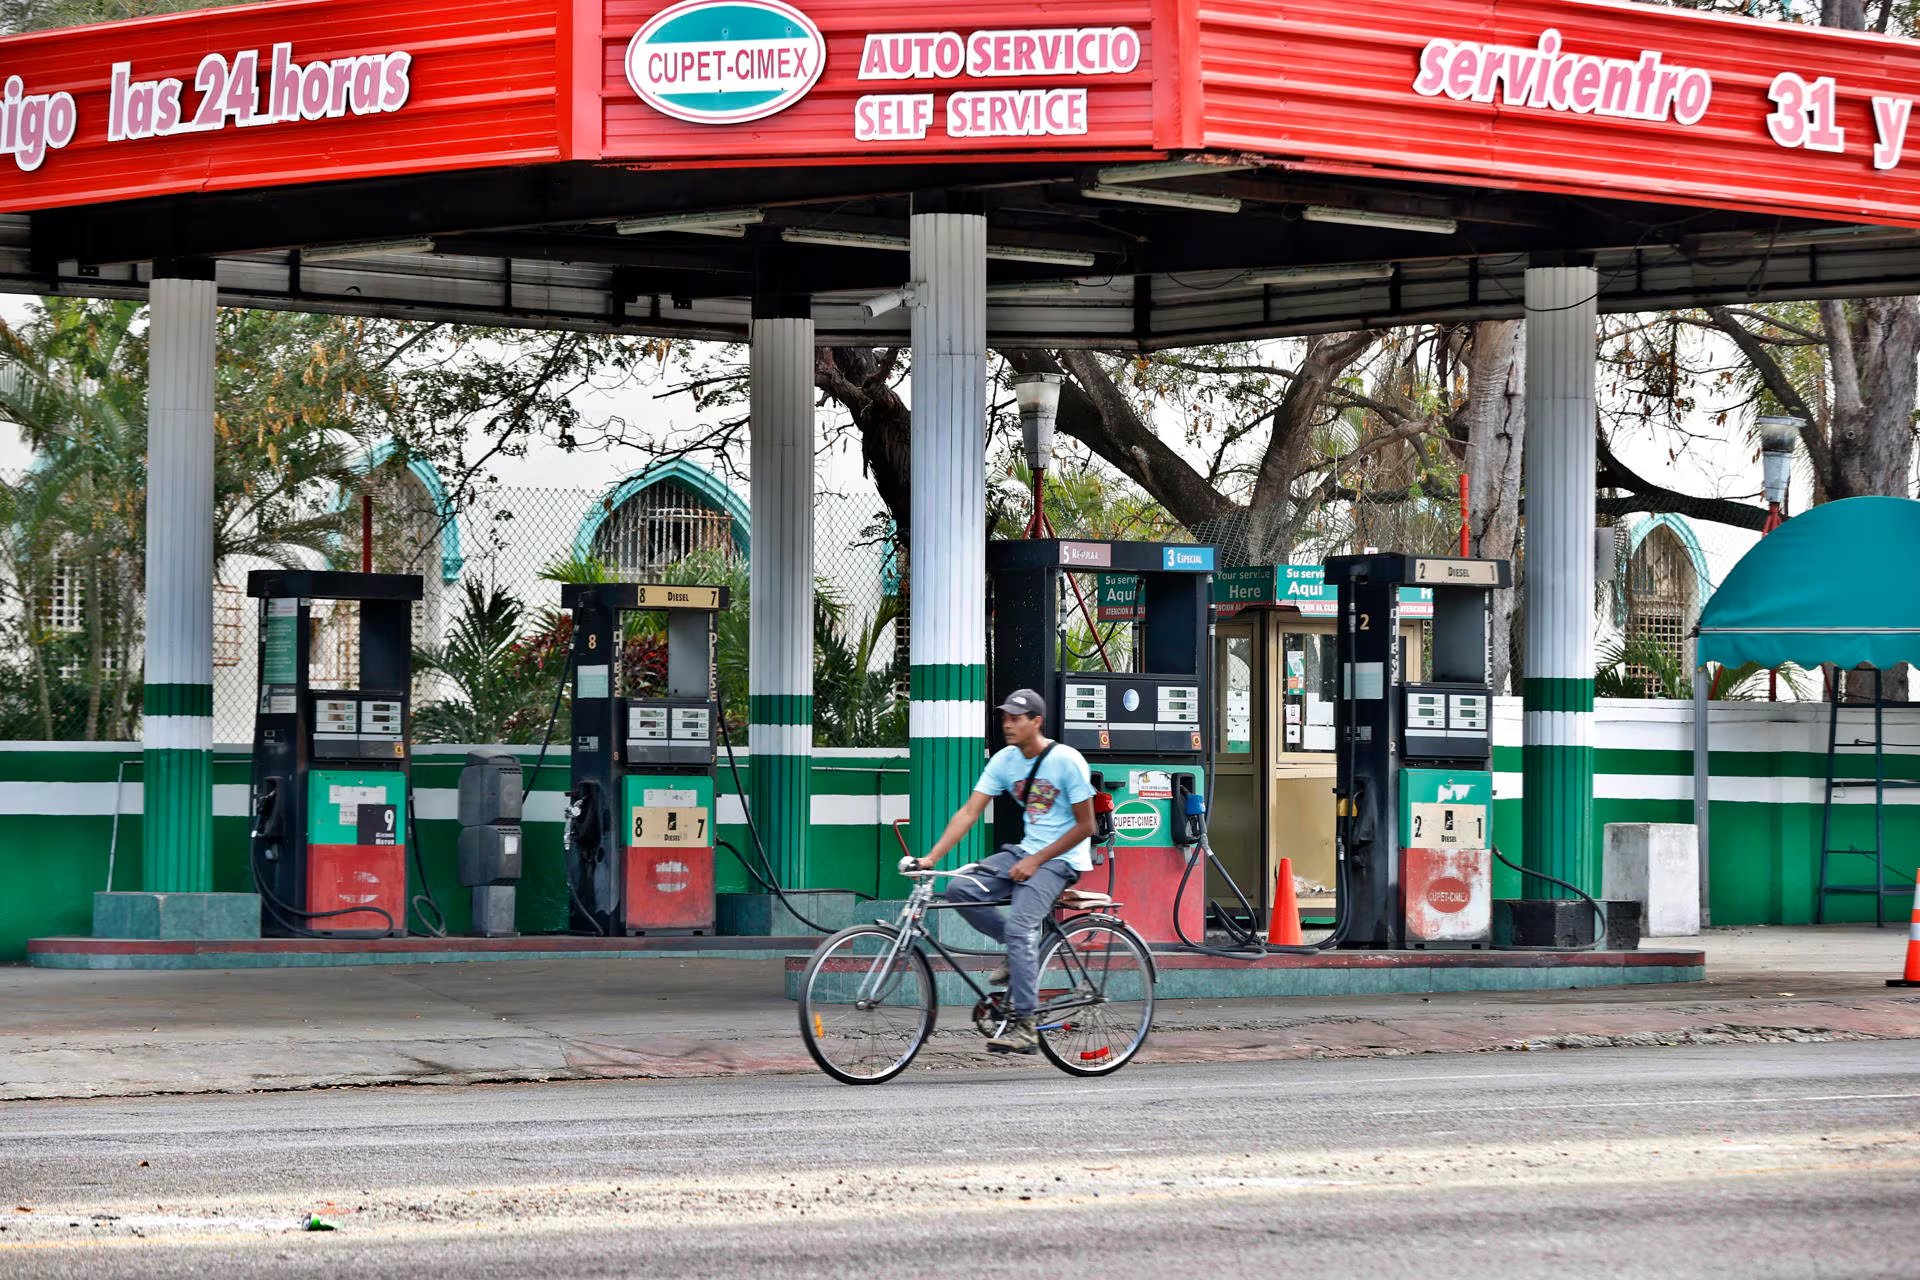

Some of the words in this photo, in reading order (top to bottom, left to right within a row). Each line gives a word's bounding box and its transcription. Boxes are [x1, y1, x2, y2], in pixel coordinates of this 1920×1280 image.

[861, 34, 964, 79] AUTO
[971, 29, 1138, 75] SERVICIO
[647, 46, 809, 84] CUPET-CIMEX
[0, 77, 75, 169] igo
[110, 65, 180, 141] las
[195, 52, 258, 129] 24
[272, 44, 410, 121] horas
[1417, 30, 1710, 123] servicentro
[1768, 74, 1842, 151] 31
[1873, 97, 1911, 167] y
[857, 95, 931, 140] SELF
[950, 90, 1085, 136] SERVICE
[1063, 545, 1070, 563] 5
[1167, 549, 1175, 567] 3
[1105, 575, 1116, 585] Su
[1117, 574, 1138, 585] servi
[1216, 571, 1236, 580] Your
[1240, 570, 1271, 580] service
[1286, 568, 1300, 579] Su
[1419, 562, 1426, 580] 2
[1489, 564, 1495, 581] 1
[639, 587, 646, 604] 8
[710, 590, 717, 606] 7
[1106, 585, 1136, 602] Aquí
[1229, 584, 1261, 599] Here
[1288, 580, 1324, 597] Aquí
[1359, 613, 1370, 630] 2
[588, 634, 597, 650] 8
[383, 809, 395, 831] 9
[635, 816, 643, 838] 8
[697, 818, 705, 839] 7
[1113, 815, 1158, 827] CUPET-CIMEX
[1414, 815, 1422, 838] 2
[1476, 817, 1482, 839] 1
